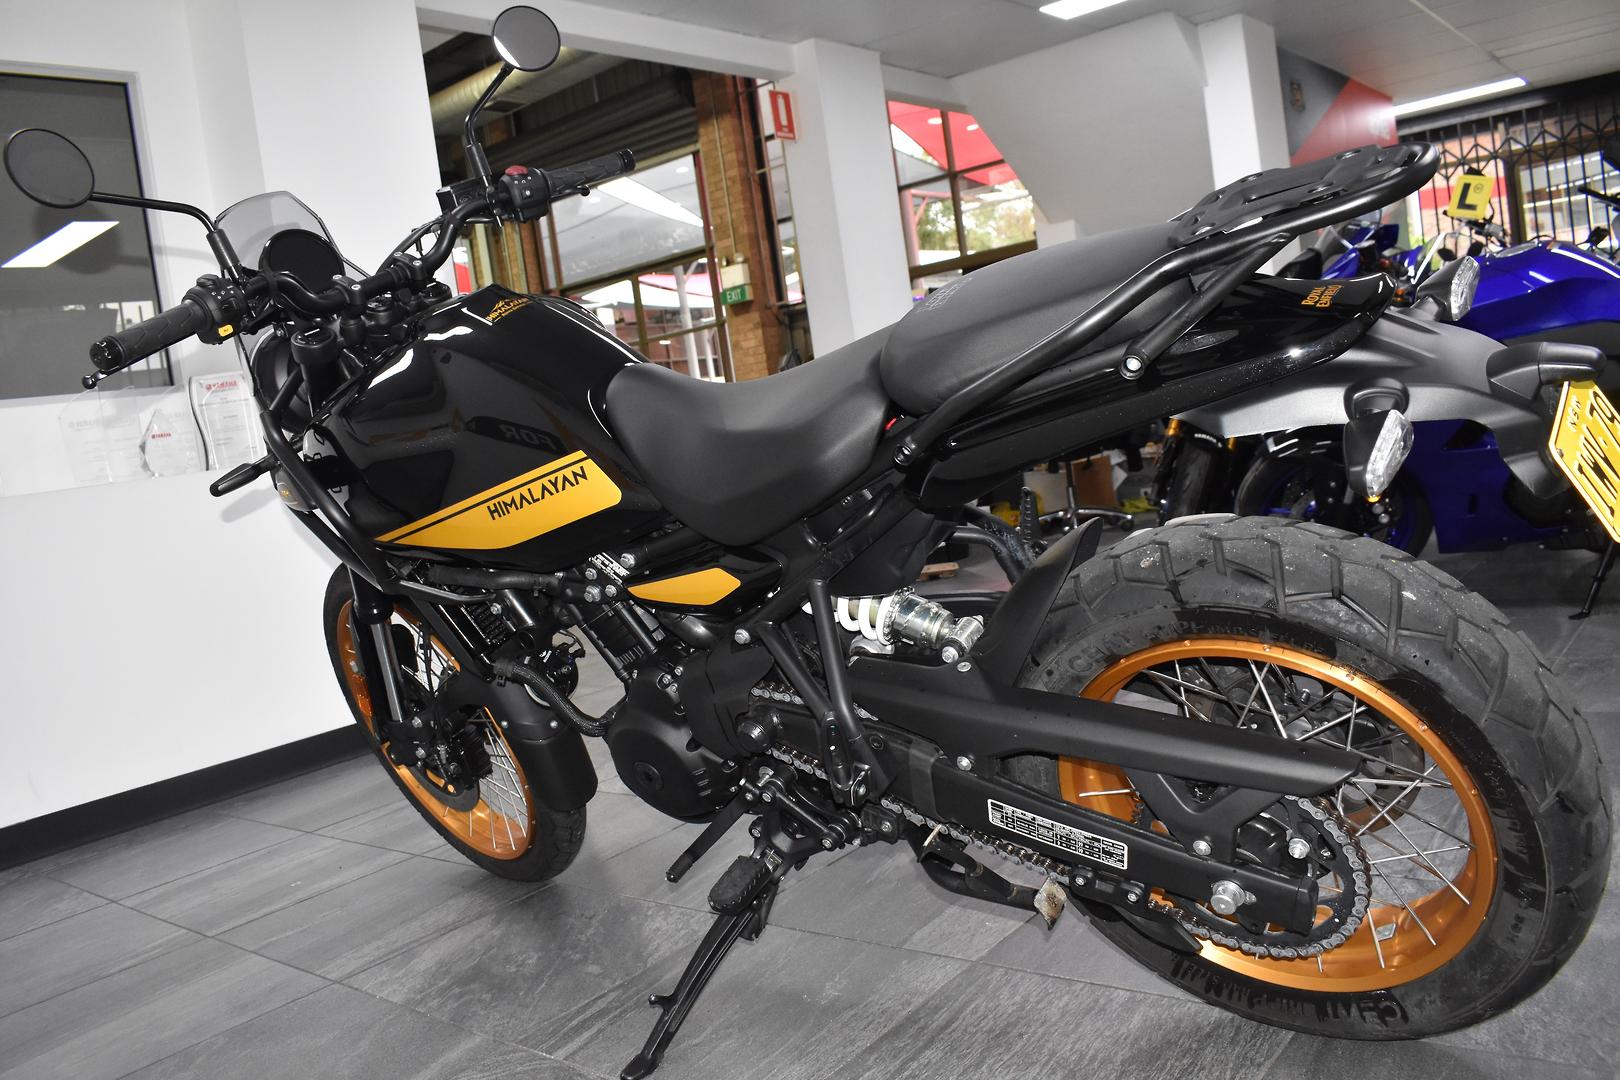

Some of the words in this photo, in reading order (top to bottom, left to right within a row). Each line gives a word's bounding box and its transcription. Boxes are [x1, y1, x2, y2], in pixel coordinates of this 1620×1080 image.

[1457, 182, 1478, 211] L
[727, 288, 742, 303] EXIT
[487, 466, 588, 521] HIMALAYAN
